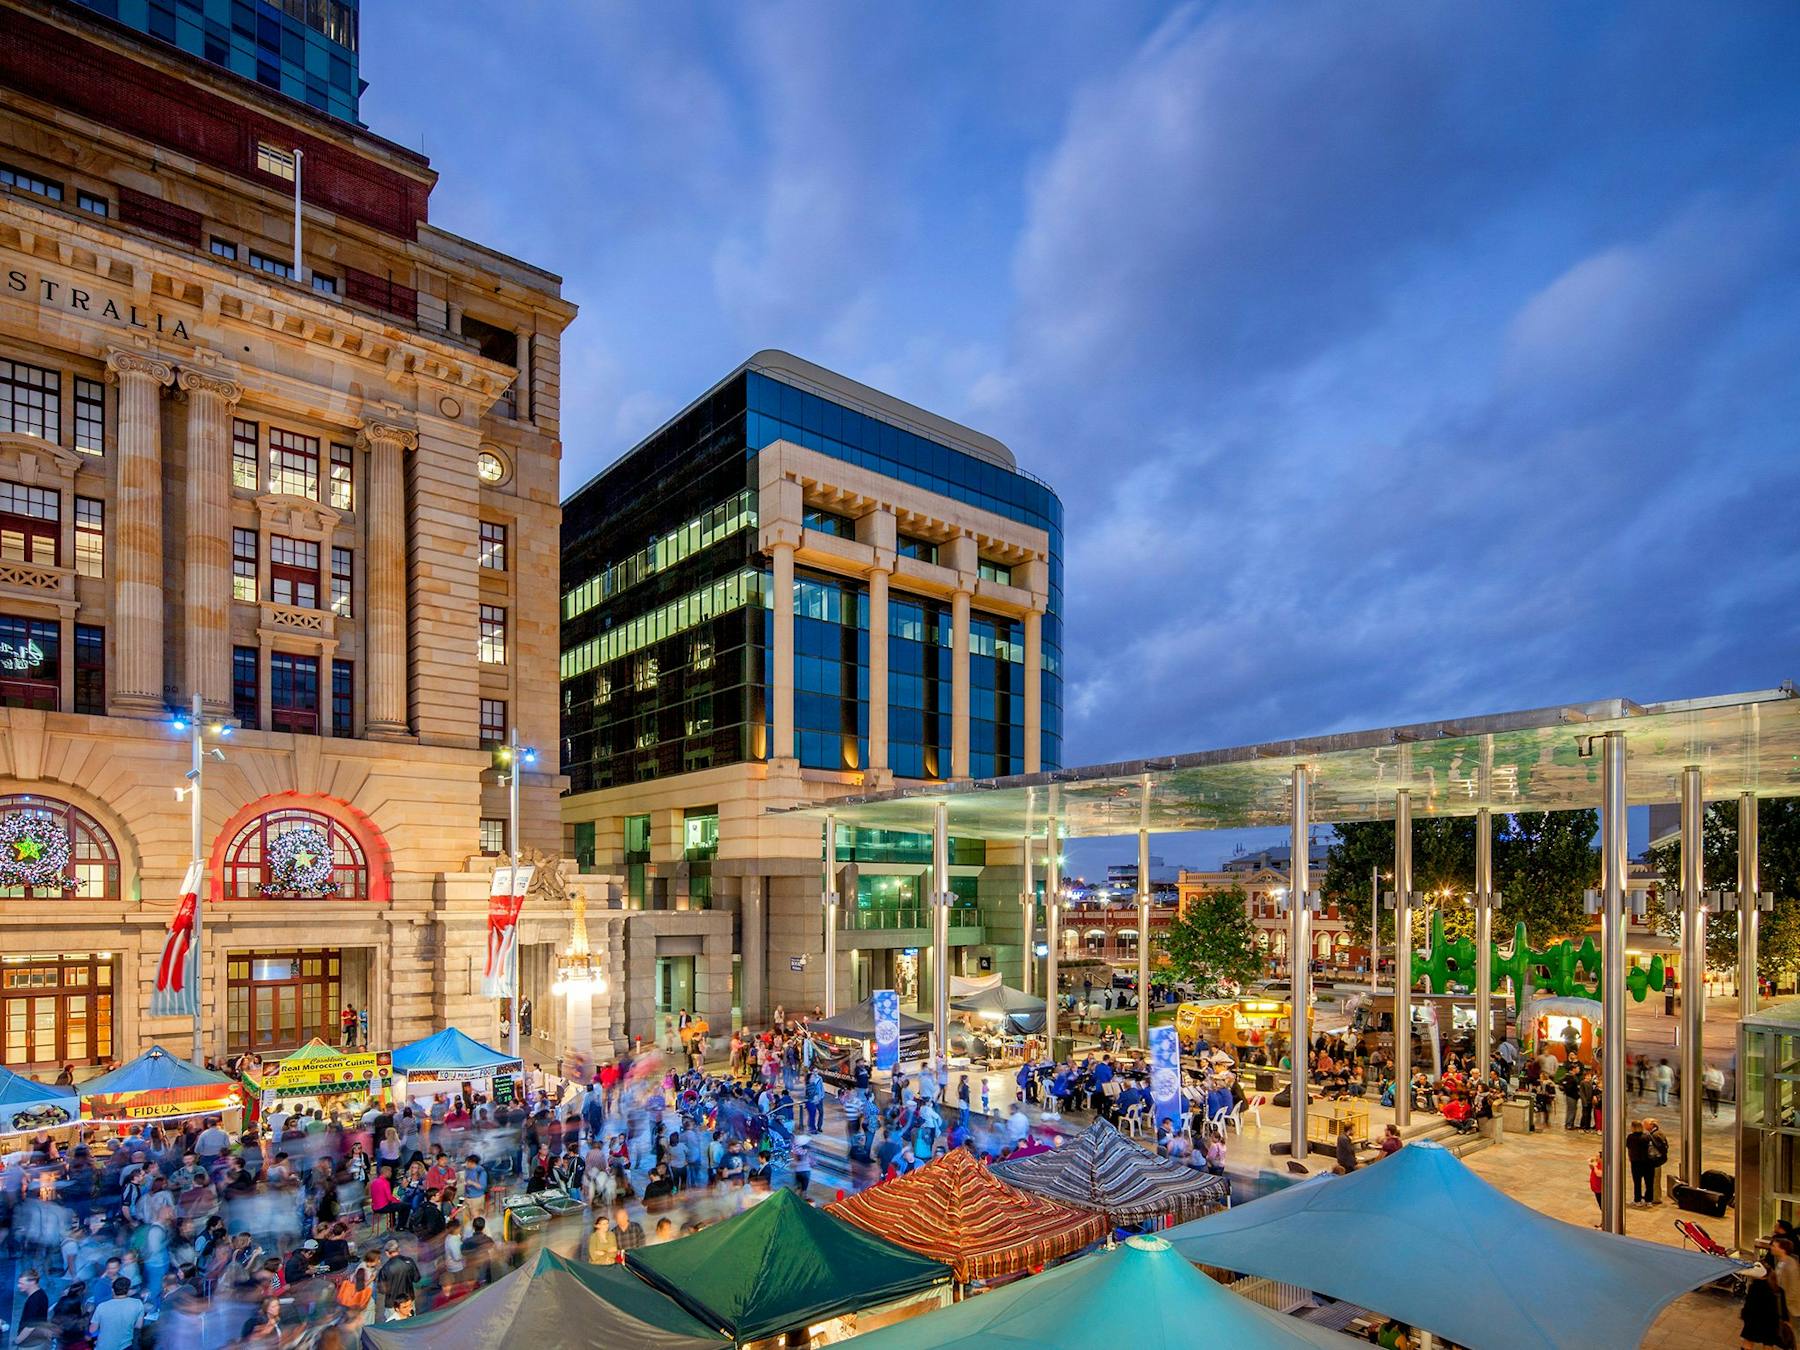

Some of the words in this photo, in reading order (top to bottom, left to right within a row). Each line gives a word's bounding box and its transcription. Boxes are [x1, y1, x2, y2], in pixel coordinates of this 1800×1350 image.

[8, 270, 190, 340] STRALIA
[281, 1064, 300, 1072] Real
[302, 1061, 343, 1071] Moroccan
[345, 1059, 376, 1067] Cuisine
